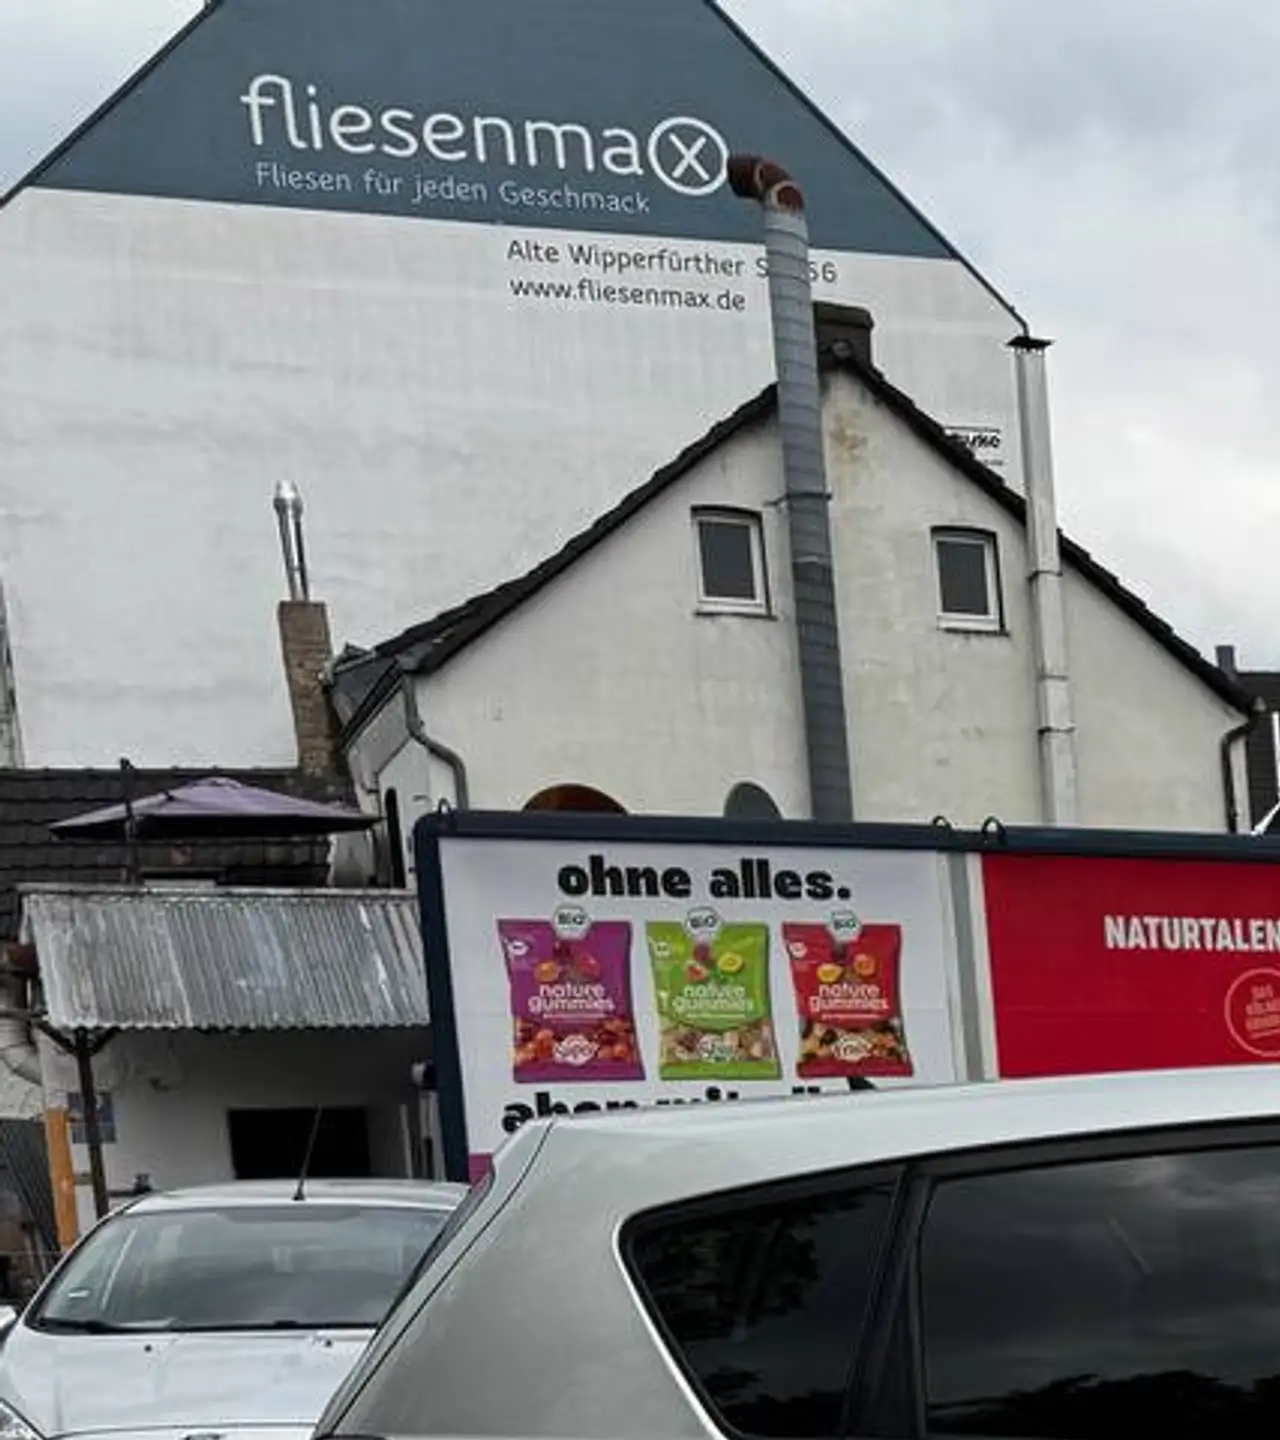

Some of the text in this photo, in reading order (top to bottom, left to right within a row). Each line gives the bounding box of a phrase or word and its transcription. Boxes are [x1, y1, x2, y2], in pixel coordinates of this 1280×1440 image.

[255, 162, 651, 214] Fliesen für jeden Geschmack
[507, 239, 559, 262] Alte
[568, 243, 746, 276] Wipperfürther
[509, 277, 747, 311] www.fliesenmax.de
[557, 854, 852, 901] ohne alles.
[539, 982, 605, 999] nature
[682, 983, 746, 999] nature
[817, 982, 881, 998] nature
[527, 996, 616, 1015] gummies
[672, 996, 754, 1013] gummies
[808, 995, 890, 1013] gummies
